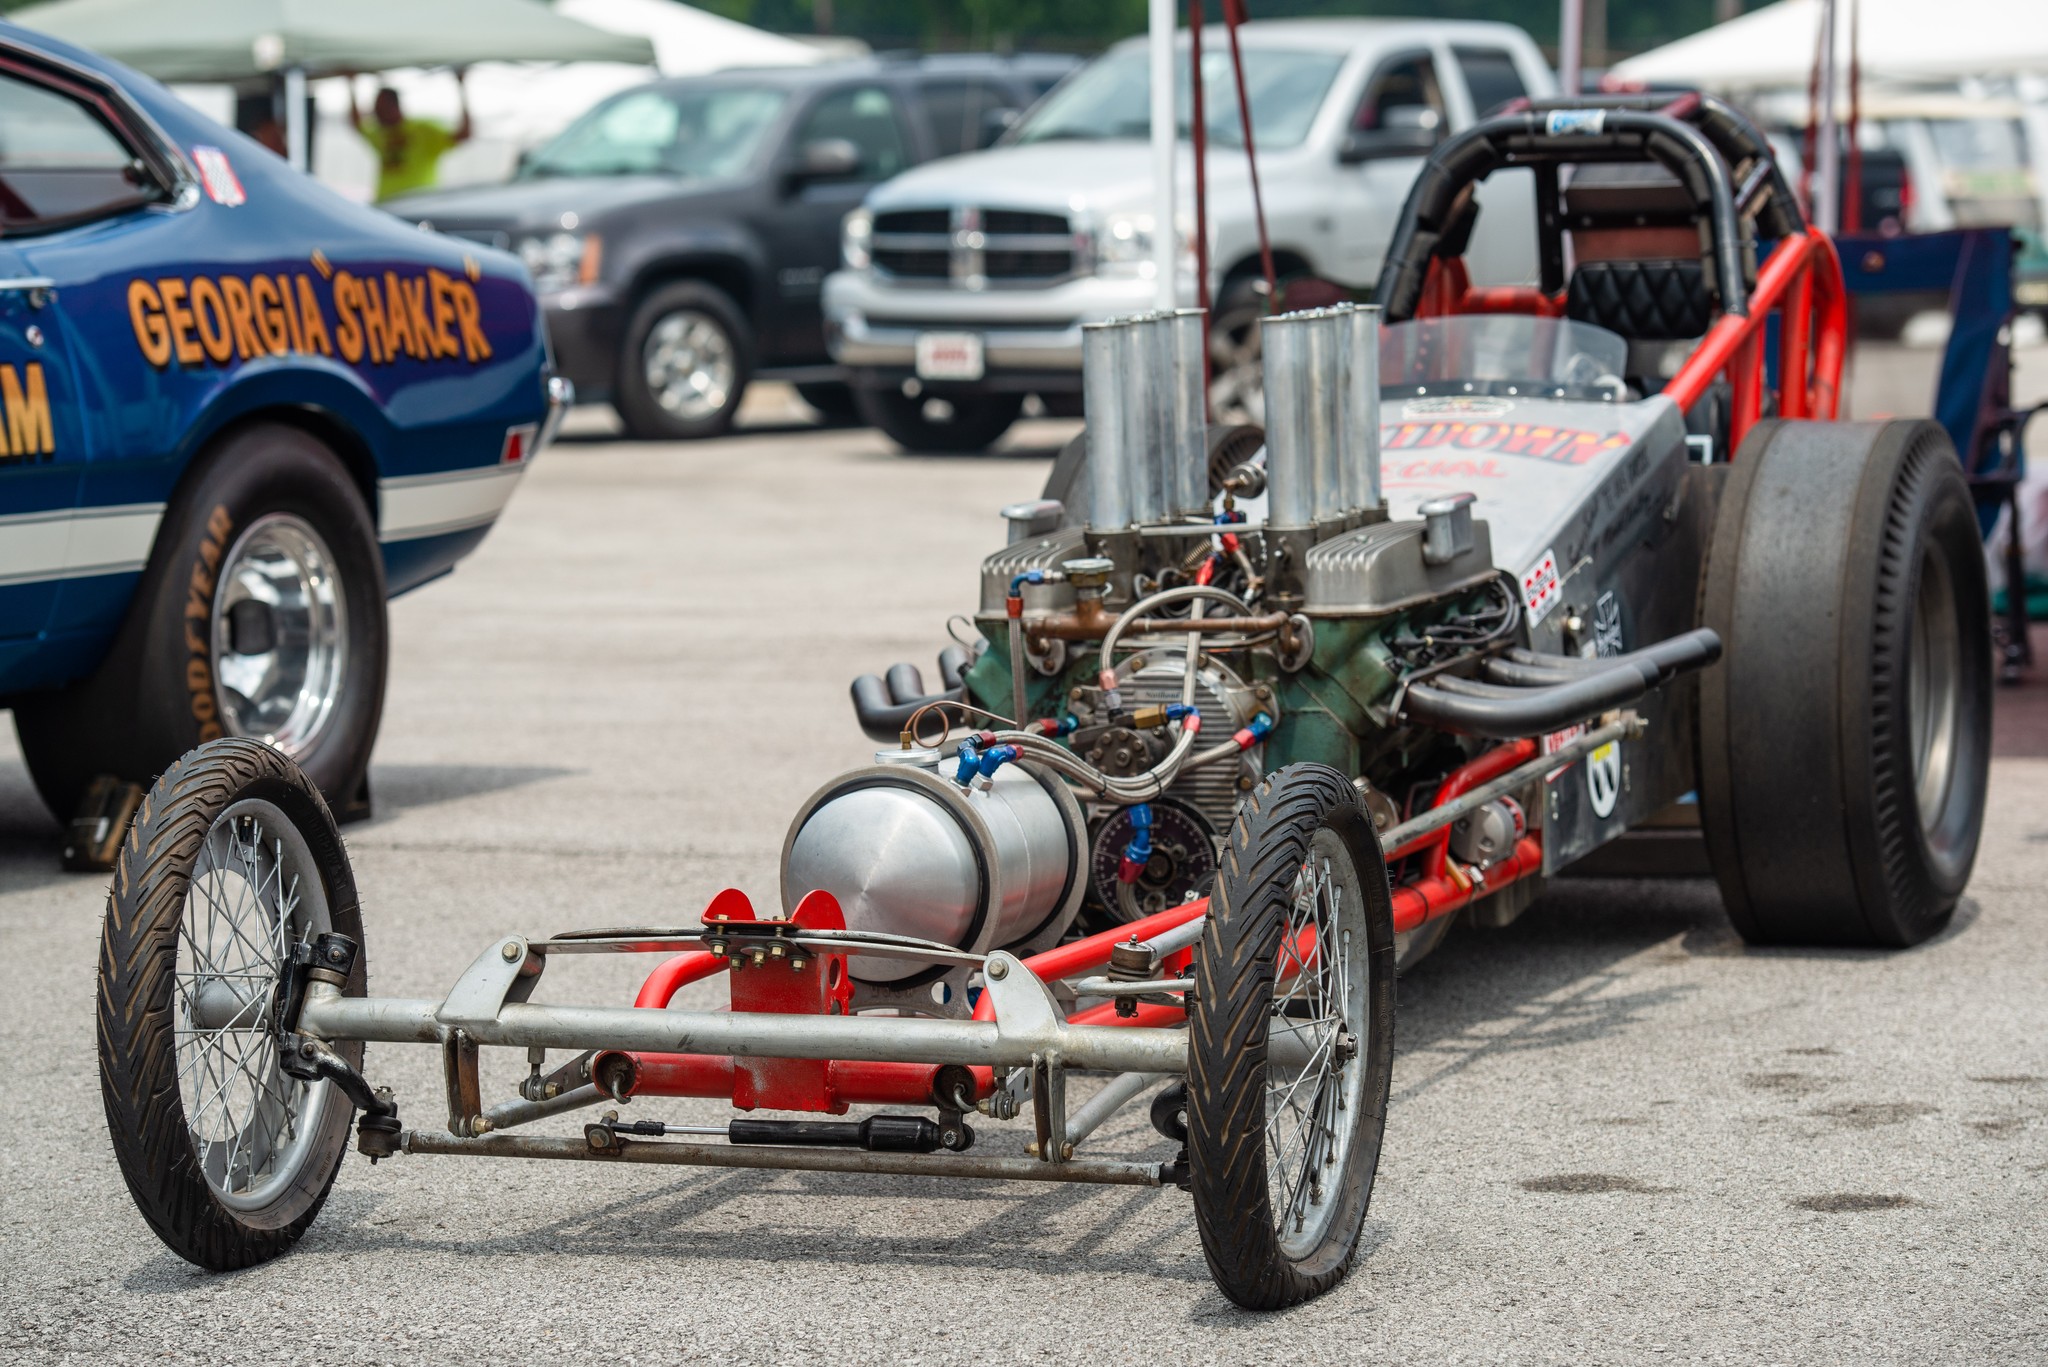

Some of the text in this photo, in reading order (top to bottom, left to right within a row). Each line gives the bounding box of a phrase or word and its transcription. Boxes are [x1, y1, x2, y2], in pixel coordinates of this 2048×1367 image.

[127, 273, 333, 367] GEORGIA
[0, 362, 56, 456] M
[1379, 420, 1632, 464] TDOWN
[1380, 459, 1509, 480] ECIAL
[185, 504, 233, 745] OODYEAR
